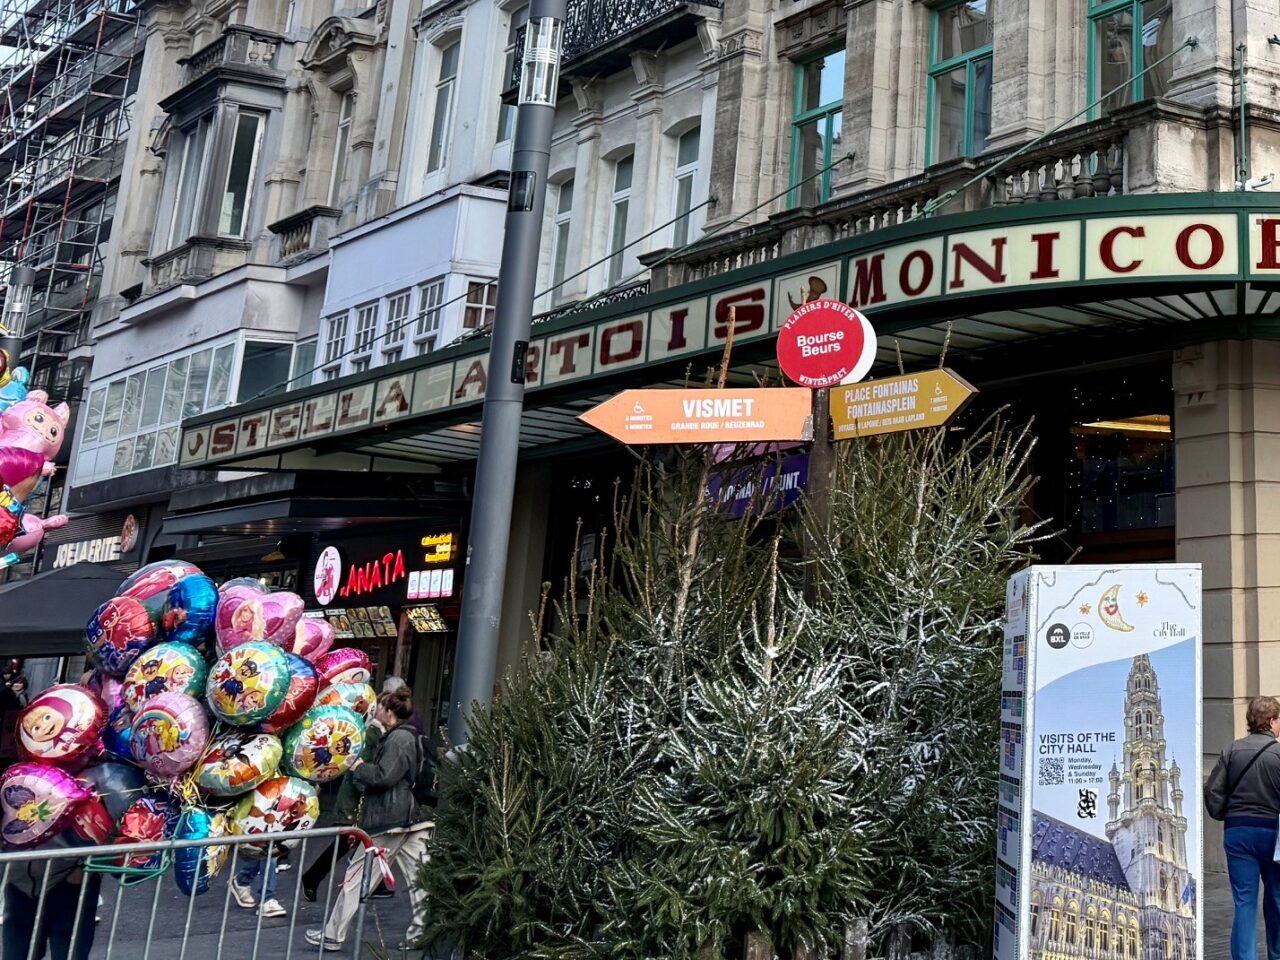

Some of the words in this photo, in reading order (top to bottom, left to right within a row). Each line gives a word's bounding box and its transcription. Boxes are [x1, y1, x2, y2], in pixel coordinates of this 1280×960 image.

[849, 224, 1224, 307] MONICO
[785, 302, 822, 330] PLAISIRS
[823, 301, 855, 321] D'HIVER
[797, 330, 844, 347] Bourse
[802, 342, 841, 357] Beurs
[799, 367, 848, 385] WINTERPRET
[844, 386, 870, 403] PLACE
[873, 378, 919, 399] FONTAINAS
[682, 399, 755, 418] VISMET
[847, 396, 916, 419] FONTAINASPLEIN
[211, 380, 409, 455] STELLA
[671, 421, 699, 430] GRANDE
[1050, 635, 1066, 643] BXL
[1040, 733, 1074, 744] VISITS
[1077, 732, 1092, 743] OF
[1094, 732, 1116, 742] THE
[1039, 744, 1064, 754] CITY
[1067, 743, 1096, 753] HALL
